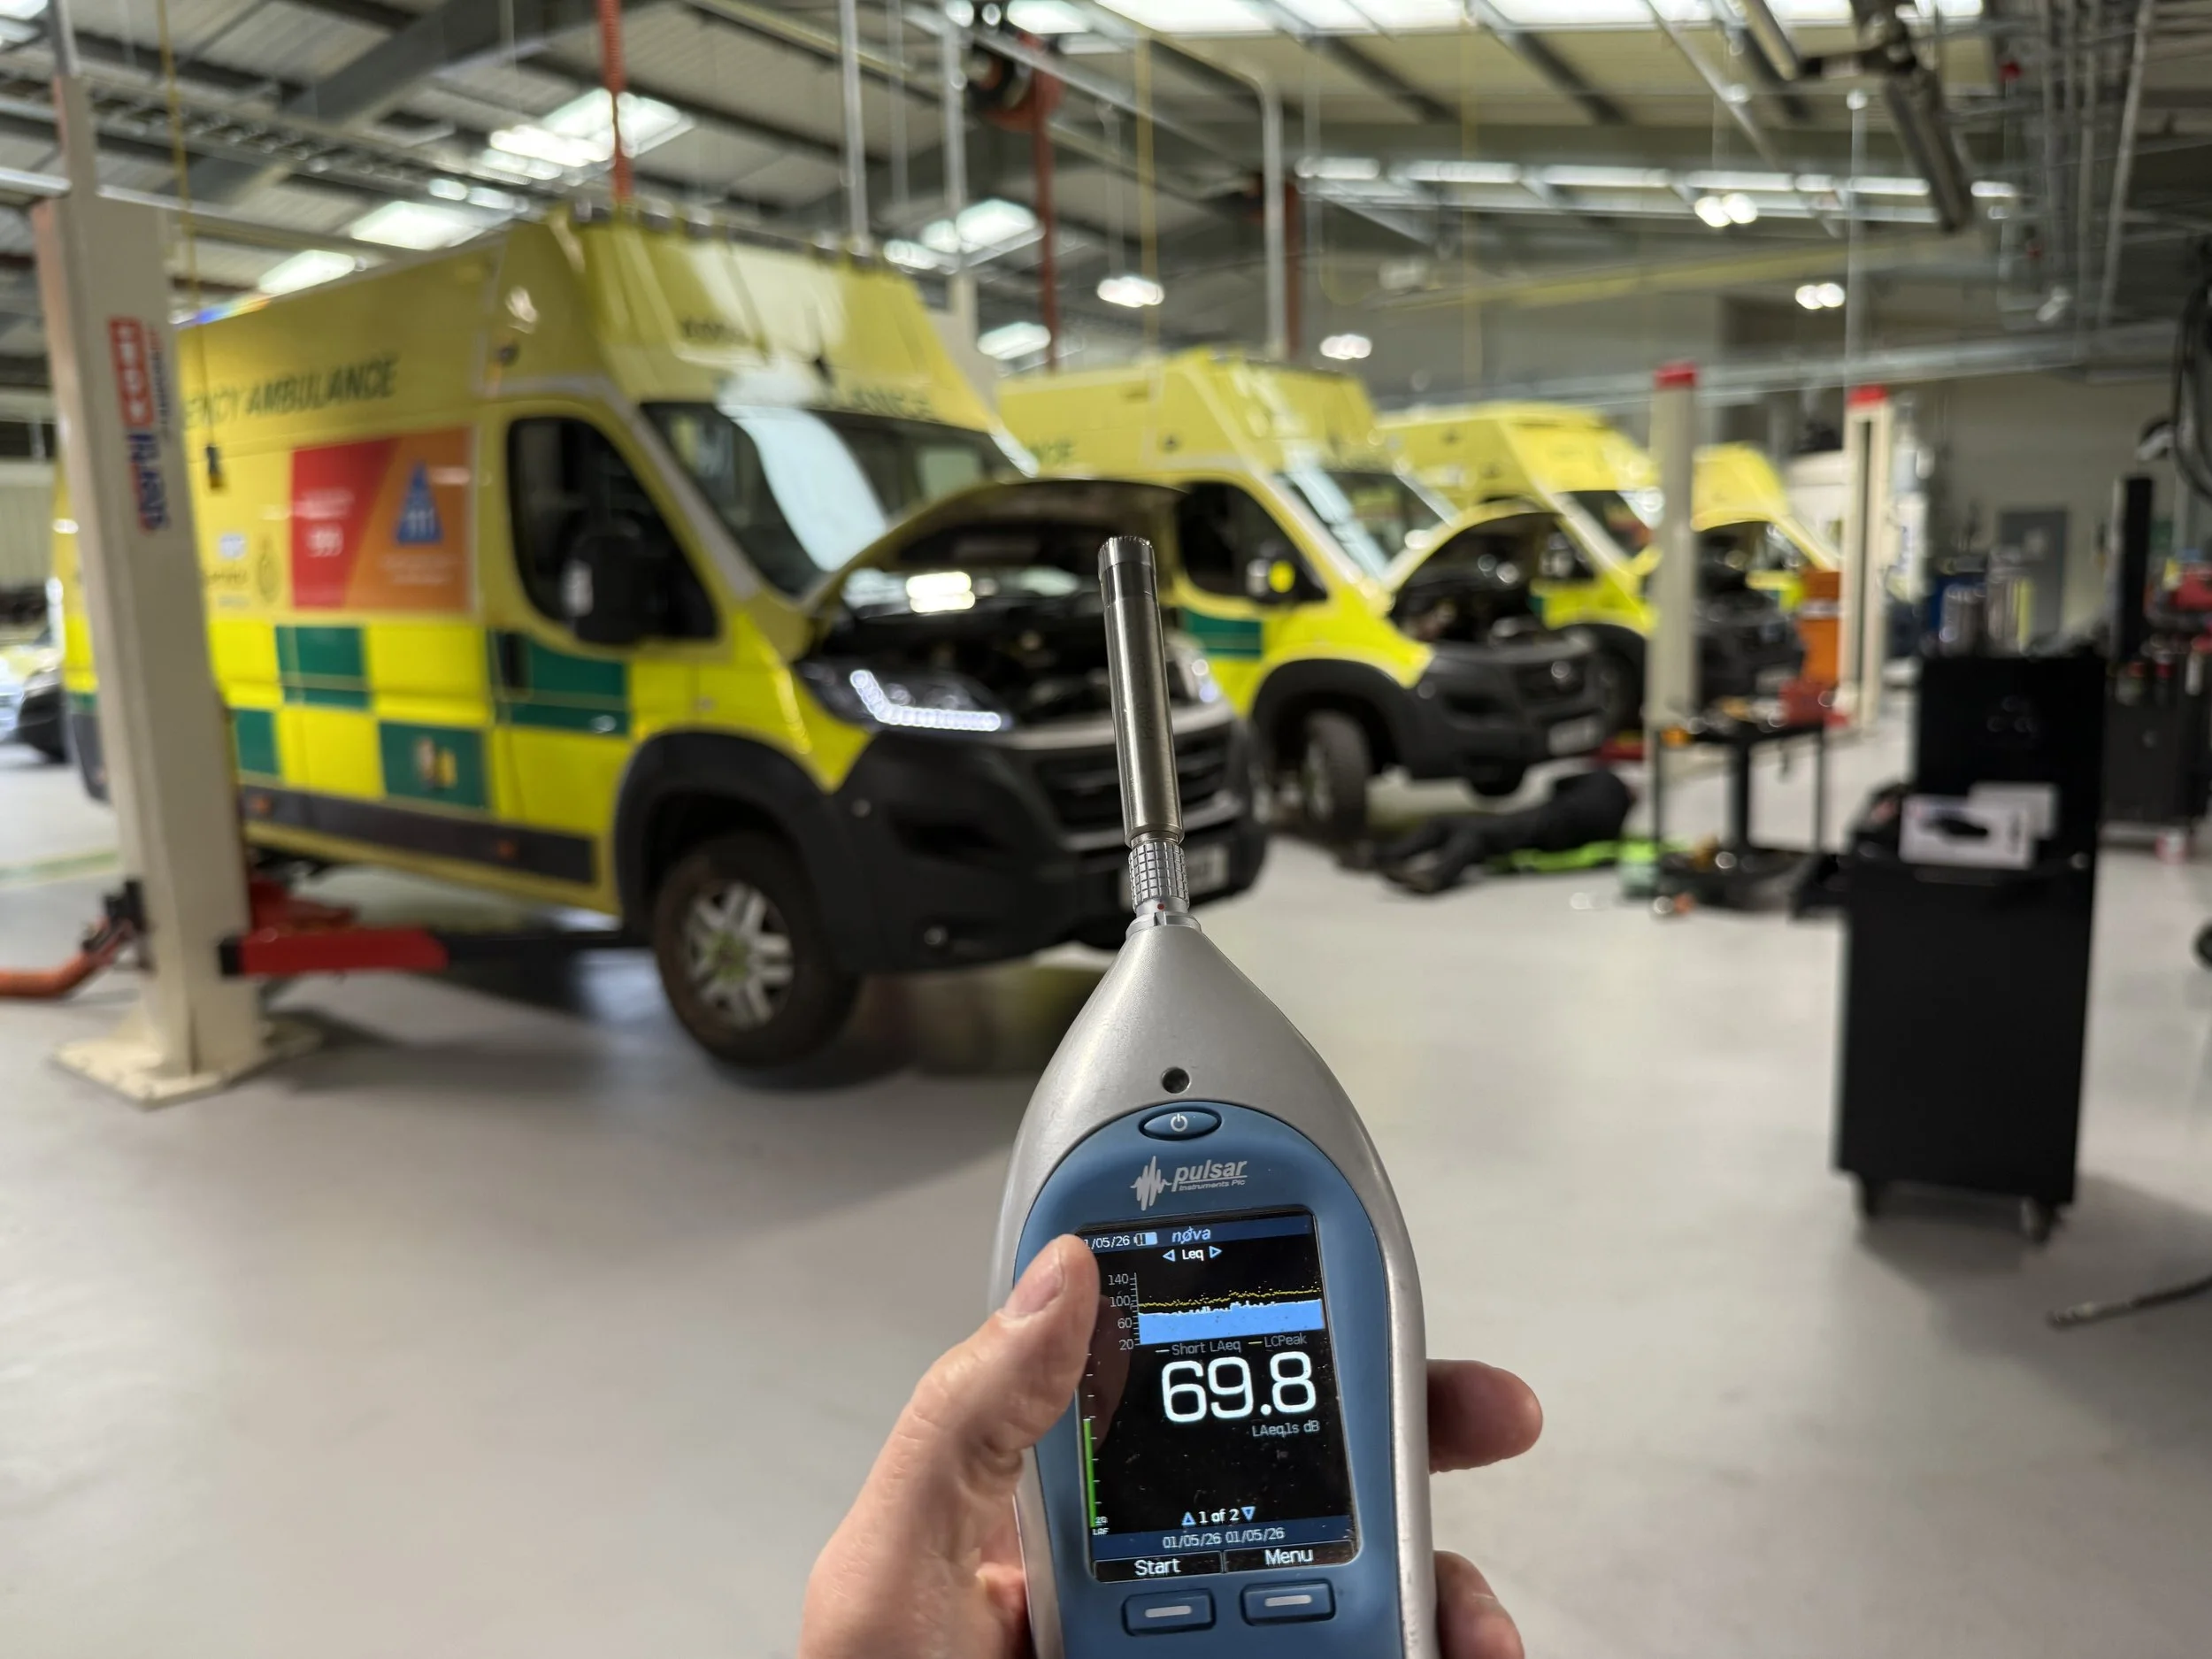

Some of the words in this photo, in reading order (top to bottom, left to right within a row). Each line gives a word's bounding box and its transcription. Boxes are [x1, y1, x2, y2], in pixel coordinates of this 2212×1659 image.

[1171, 1159, 1248, 1192] pulsar
[1179, 1181, 1229, 1192] Instruments
[1084, 1234, 1131, 1250] 1/05/26
[1181, 1249, 1204, 1262] Leq
[1108, 1273, 1129, 1286] 140
[1110, 1295, 1131, 1308] 100
[1118, 1317, 1133, 1329] 60
[1119, 1339, 1134, 1351] 20
[1171, 1343, 1206, 1356] Short
[1210, 1340, 1241, 1354] LAeq
[1263, 1333, 1308, 1348] LCPeak
[1162, 1351, 1317, 1423] 69.8
[1303, 1419, 1320, 1432] dB
[1198, 1511, 1209, 1524] 1
[1211, 1509, 1225, 1523] of
[1229, 1508, 1240, 1521] 2
[1163, 1532, 1223, 1548] 01/05/26
[1225, 1527, 1286, 1544] 01/05/26
[1264, 1548, 1314, 1565] Menu
[1134, 1558, 1181, 1576] Start
